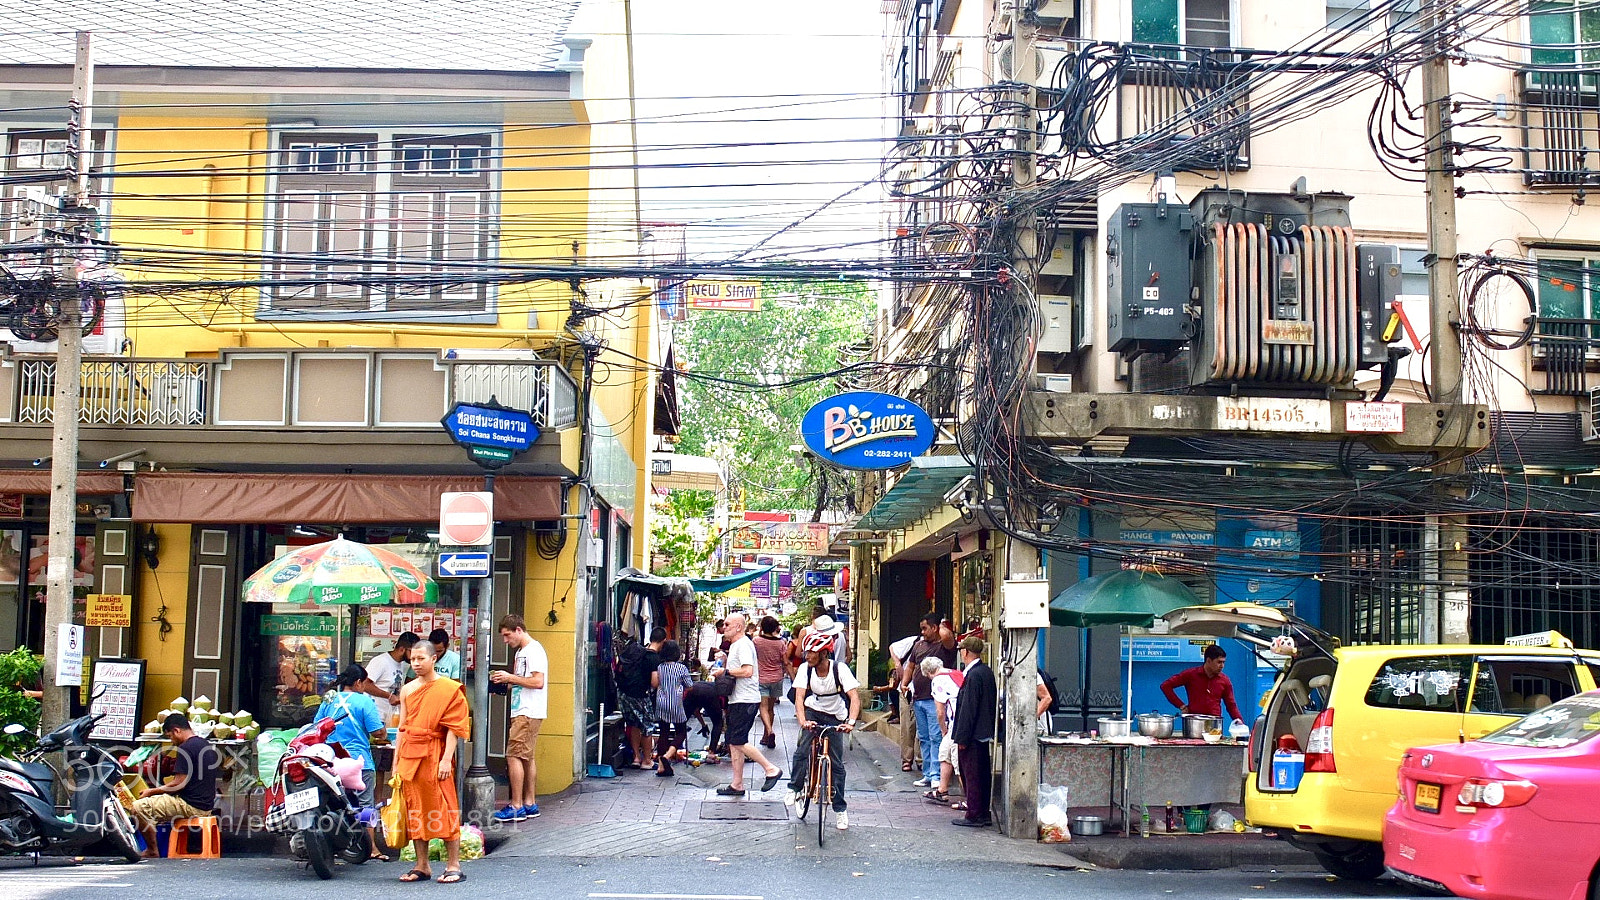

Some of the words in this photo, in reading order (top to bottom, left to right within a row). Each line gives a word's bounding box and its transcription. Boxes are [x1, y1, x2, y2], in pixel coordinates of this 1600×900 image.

[691, 284, 720, 297] NEW
[725, 284, 756, 299] SIAM
[457, 411, 527, 433] ซอยชนะสงคราม
[870, 413, 915, 434] HOUSE
[458, 428, 469, 437] Soi
[470, 429, 490, 440] Chana
[492, 432, 526, 444] Songkhram
[863, 450, 912, 458] 02-282-2411
[764, 530, 818, 540] KHAOSAN
[1171, 532, 1211, 541] PAYPOINT
[762, 540, 782, 551] ART
[785, 540, 821, 551] HOTEL
[1252, 537, 1282, 548] ATM
[450, 560, 486, 568] เดินรถทางเดียว
[1449, 601, 1464, 612] 26
[100, 664, 132, 678] Rinda
